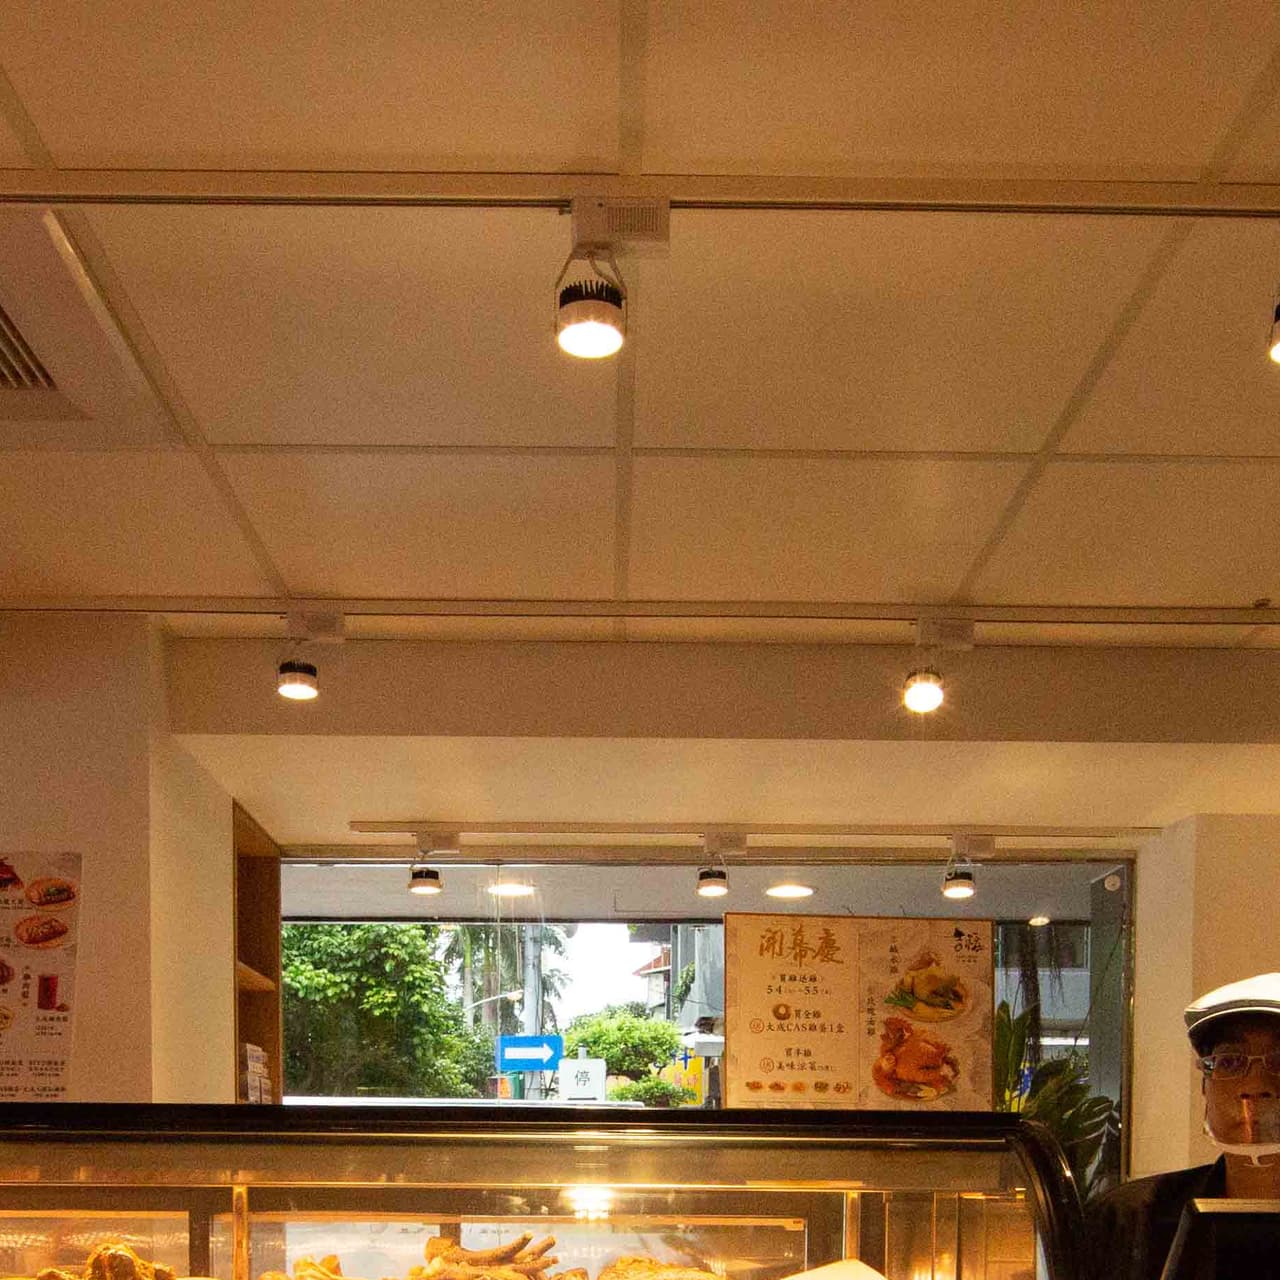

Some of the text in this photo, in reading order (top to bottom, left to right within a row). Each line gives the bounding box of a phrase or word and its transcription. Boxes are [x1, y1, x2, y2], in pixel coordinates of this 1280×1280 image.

[759, 925, 844, 968] 開幕慶
[574, 1070, 590, 1088] 停
